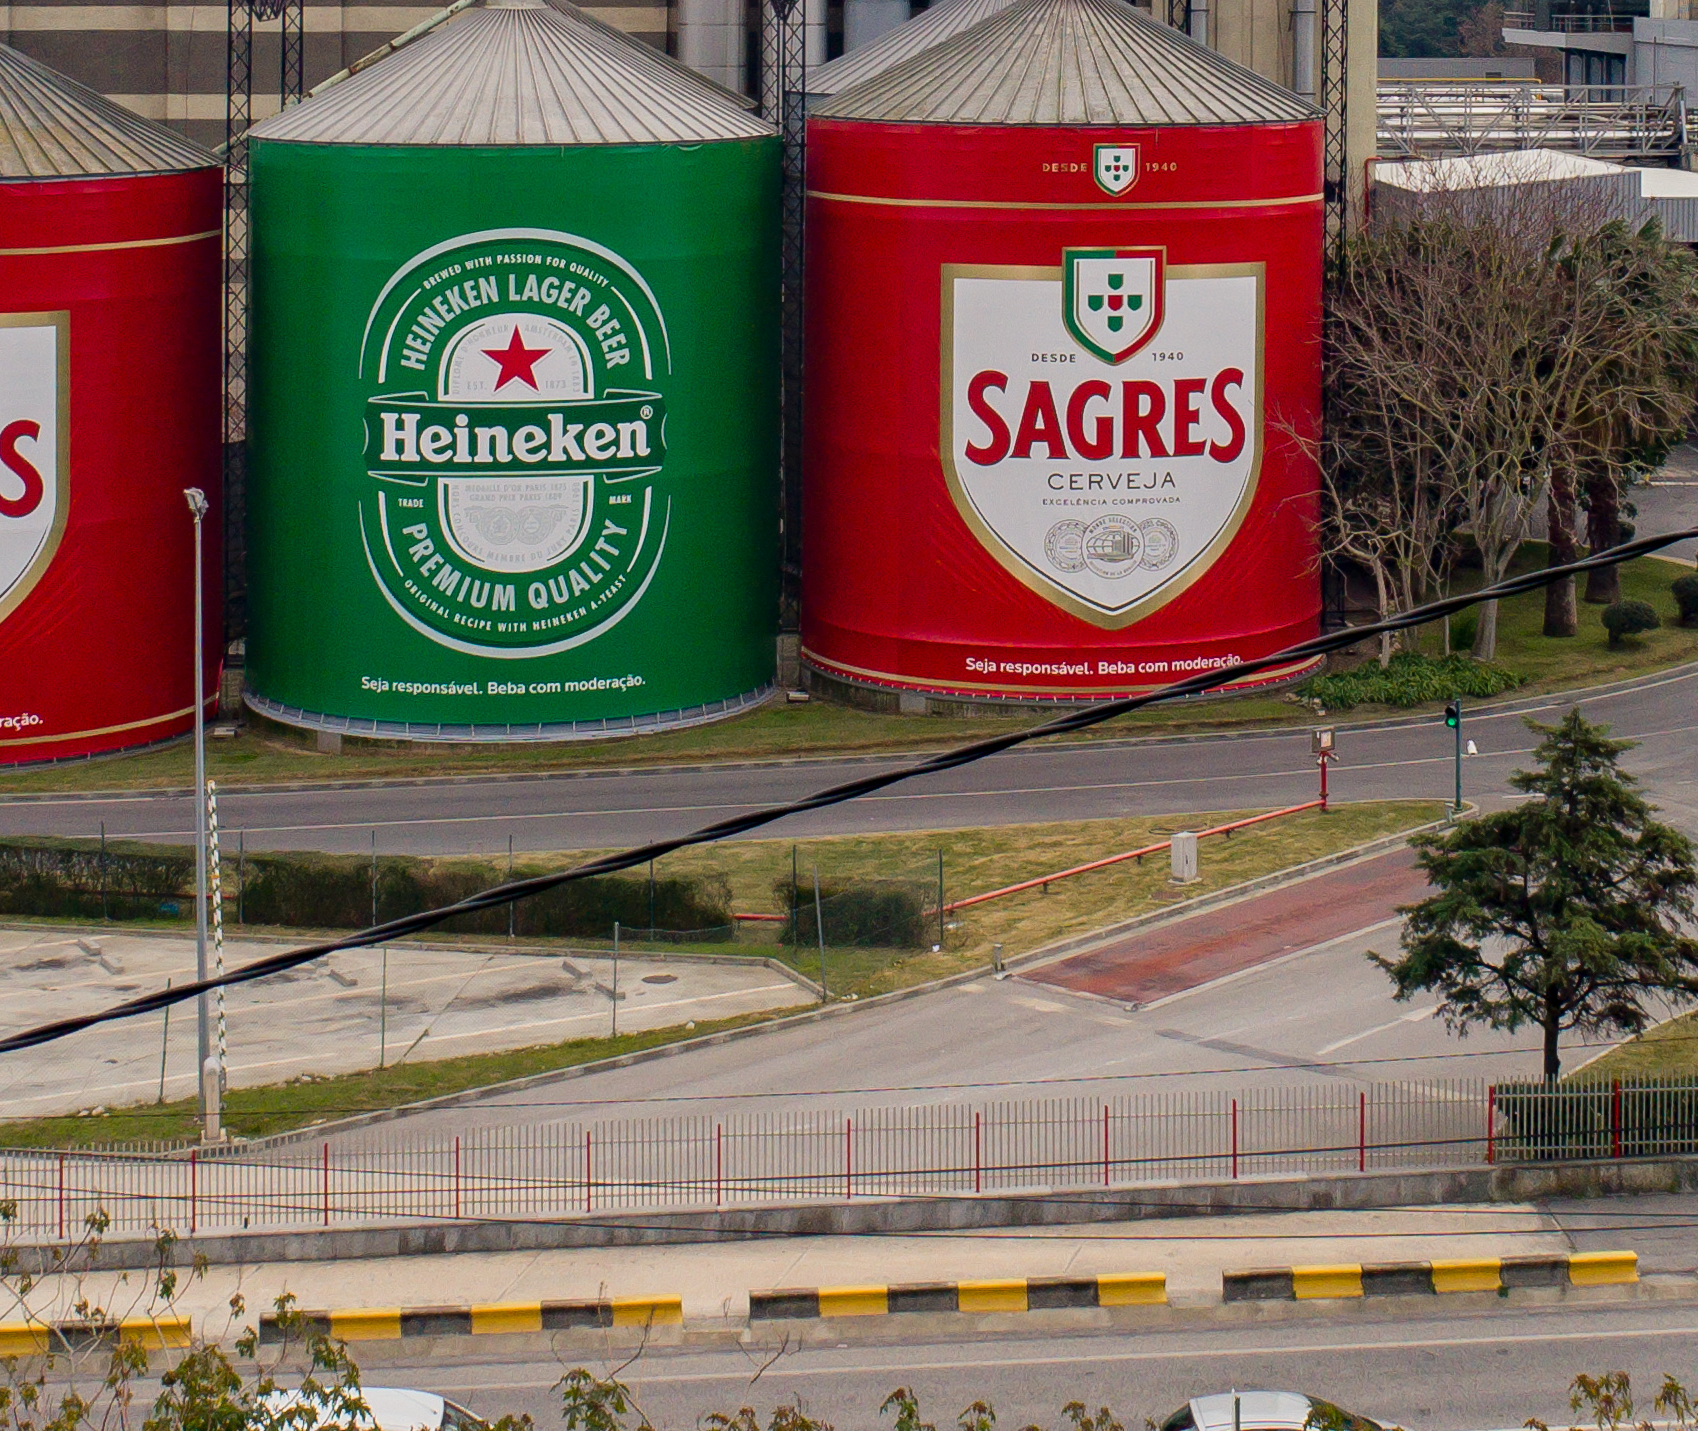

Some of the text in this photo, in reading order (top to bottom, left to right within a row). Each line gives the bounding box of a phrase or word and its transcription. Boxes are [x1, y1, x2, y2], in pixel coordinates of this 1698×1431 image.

[1042, 162, 1088, 172] DESDE
[1145, 162, 1178, 172] 1940
[422, 253, 610, 290] BREWED WITH PASSION FOR QUALITY
[401, 273, 631, 371] HEINEKEN LAGER BEER
[1031, 352, 1077, 364] DESDE
[1151, 351, 1185, 362] 1940
[964, 367, 1247, 467] SAGRES
[1047, 471, 1177, 491] CERVEJA
[398, 497, 424, 508] TRADE
[608, 494, 632, 505] MARK
[1042, 496, 1181, 506] EXCELÊNCIA COMPROVADA
[402, 518, 628, 612] PREMIUM QUALITY
[404, 578, 451, 619] ORIGINAL
[453, 612, 492, 631] RECIPE
[497, 621, 528, 633] WITH
[532, 606, 588, 630] HEINEKEN
[965, 653, 1244, 676] Seja responsável. Beba com moderação.
[361, 673, 646, 695] Seja responsável. Beba com moderação.
